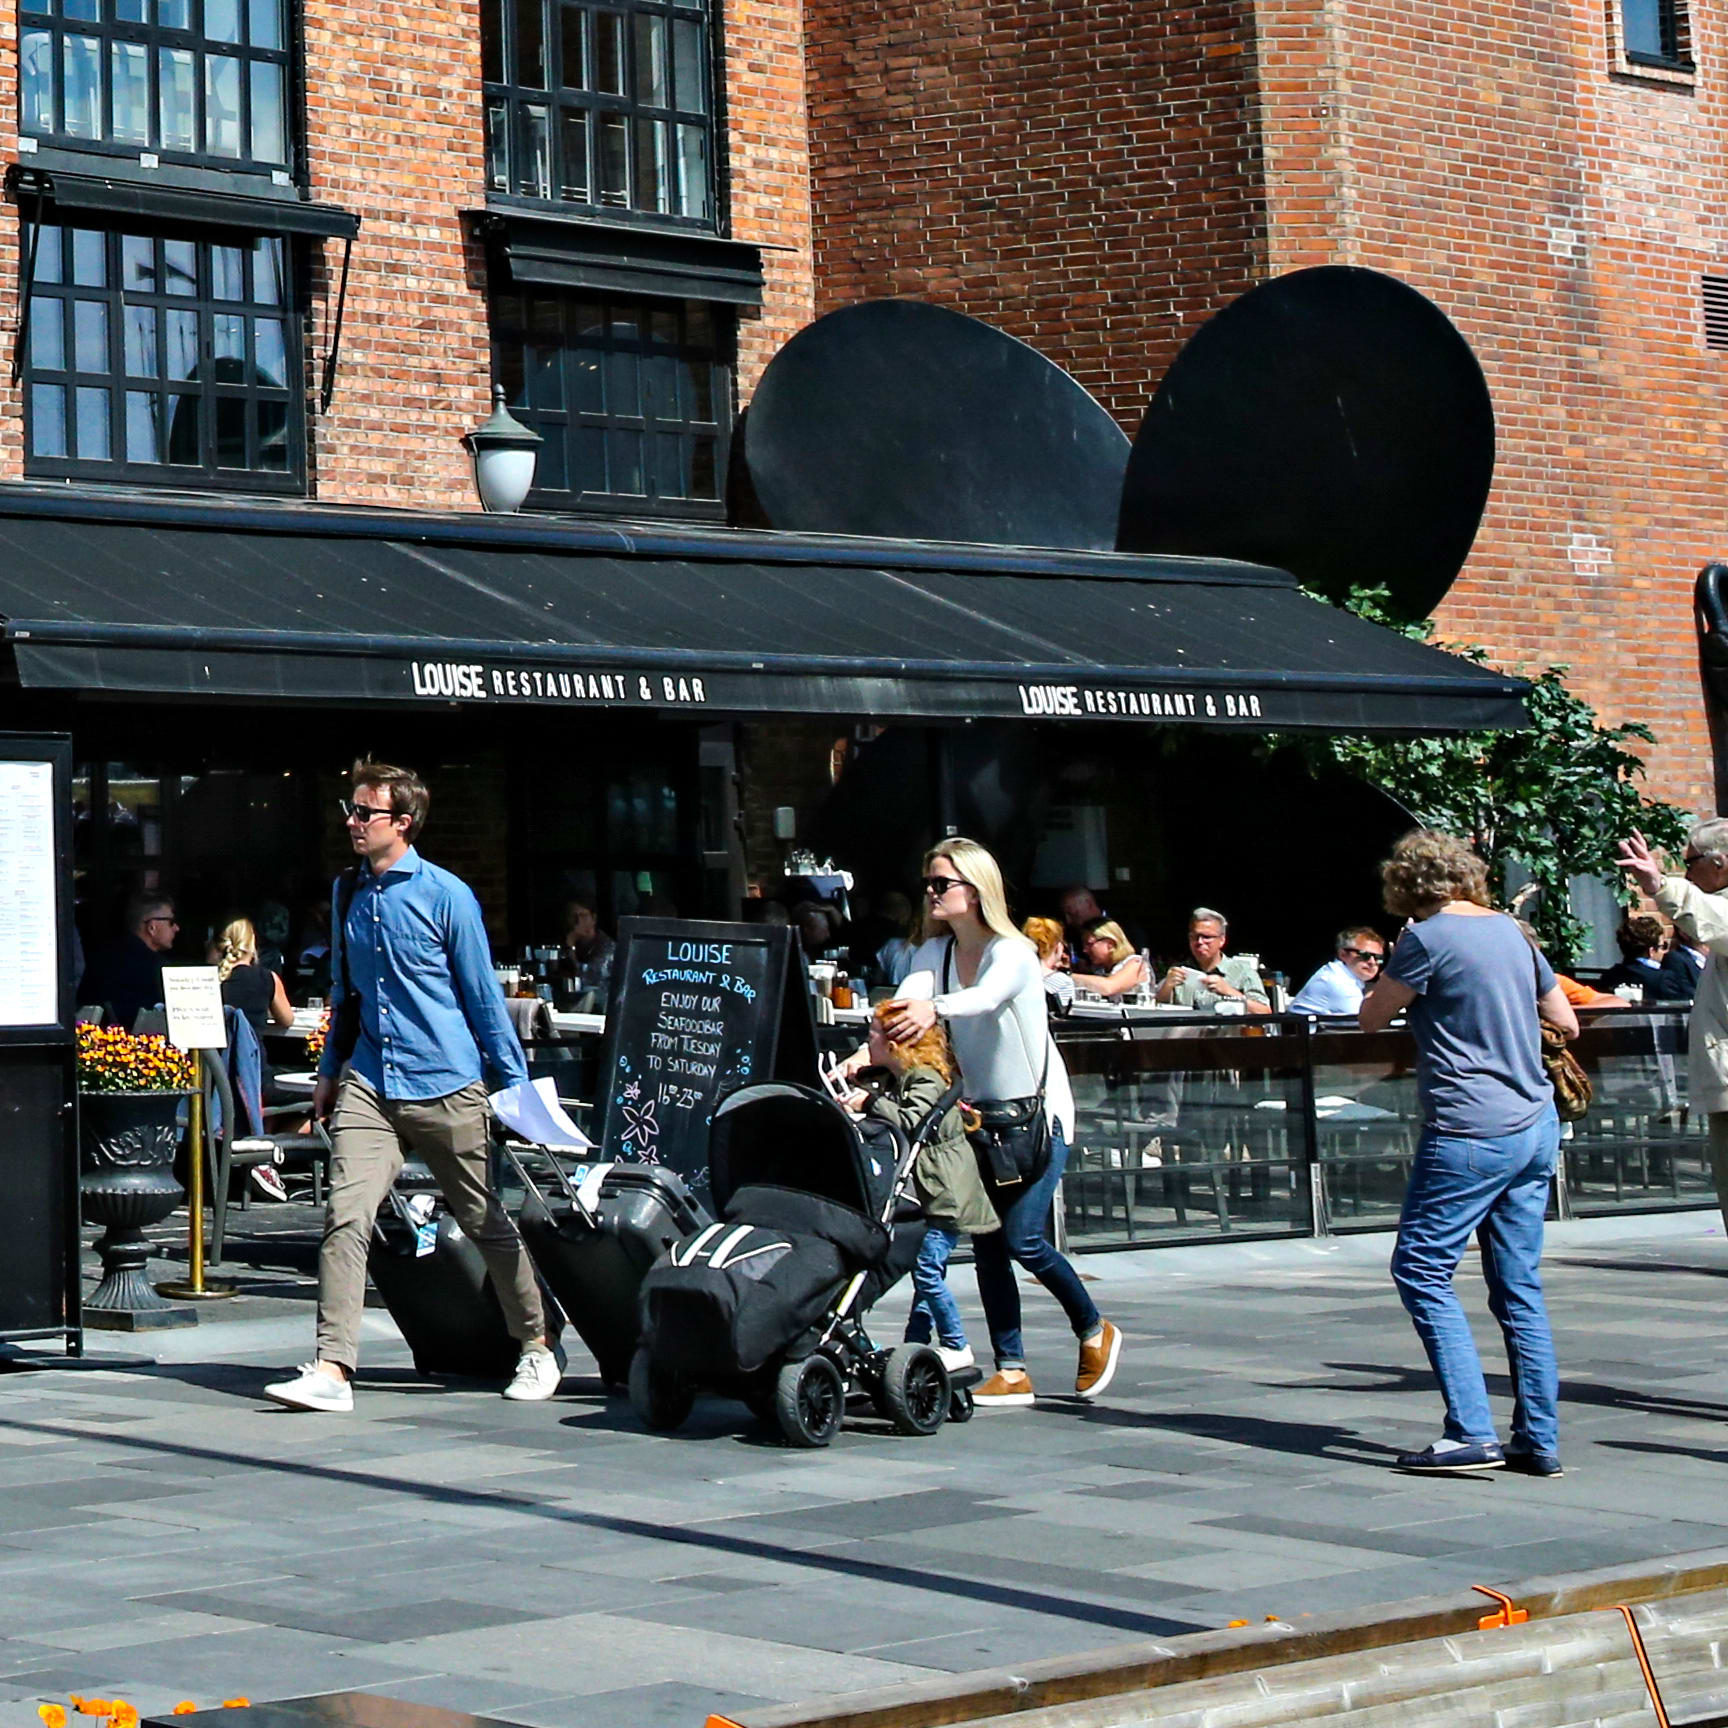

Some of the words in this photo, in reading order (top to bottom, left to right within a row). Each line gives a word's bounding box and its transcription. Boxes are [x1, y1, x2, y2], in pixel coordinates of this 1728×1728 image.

[411, 661, 487, 698] LOUISE
[492, 670, 626, 700] RESTAURANT
[639, 676, 652, 701] &
[663, 676, 706, 702] BAR
[1018, 685, 1083, 715] LOUISE
[1084, 690, 1196, 716] RESTAURANT
[1204, 695, 1217, 717] &
[1225, 695, 1262, 717] BAR
[667, 941, 734, 965] LOUISE
[642, 968, 717, 985] RESTAURANT
[719, 974, 731, 991] &
[733, 976, 757, 1004] BAR
[660, 991, 699, 1010] ENJOY
[701, 994, 722, 1013] OUR
[650, 1032, 678, 1051] FROM
[645, 1054, 662, 1070] TO
[667, 1056, 717, 1080] SATURDAY
